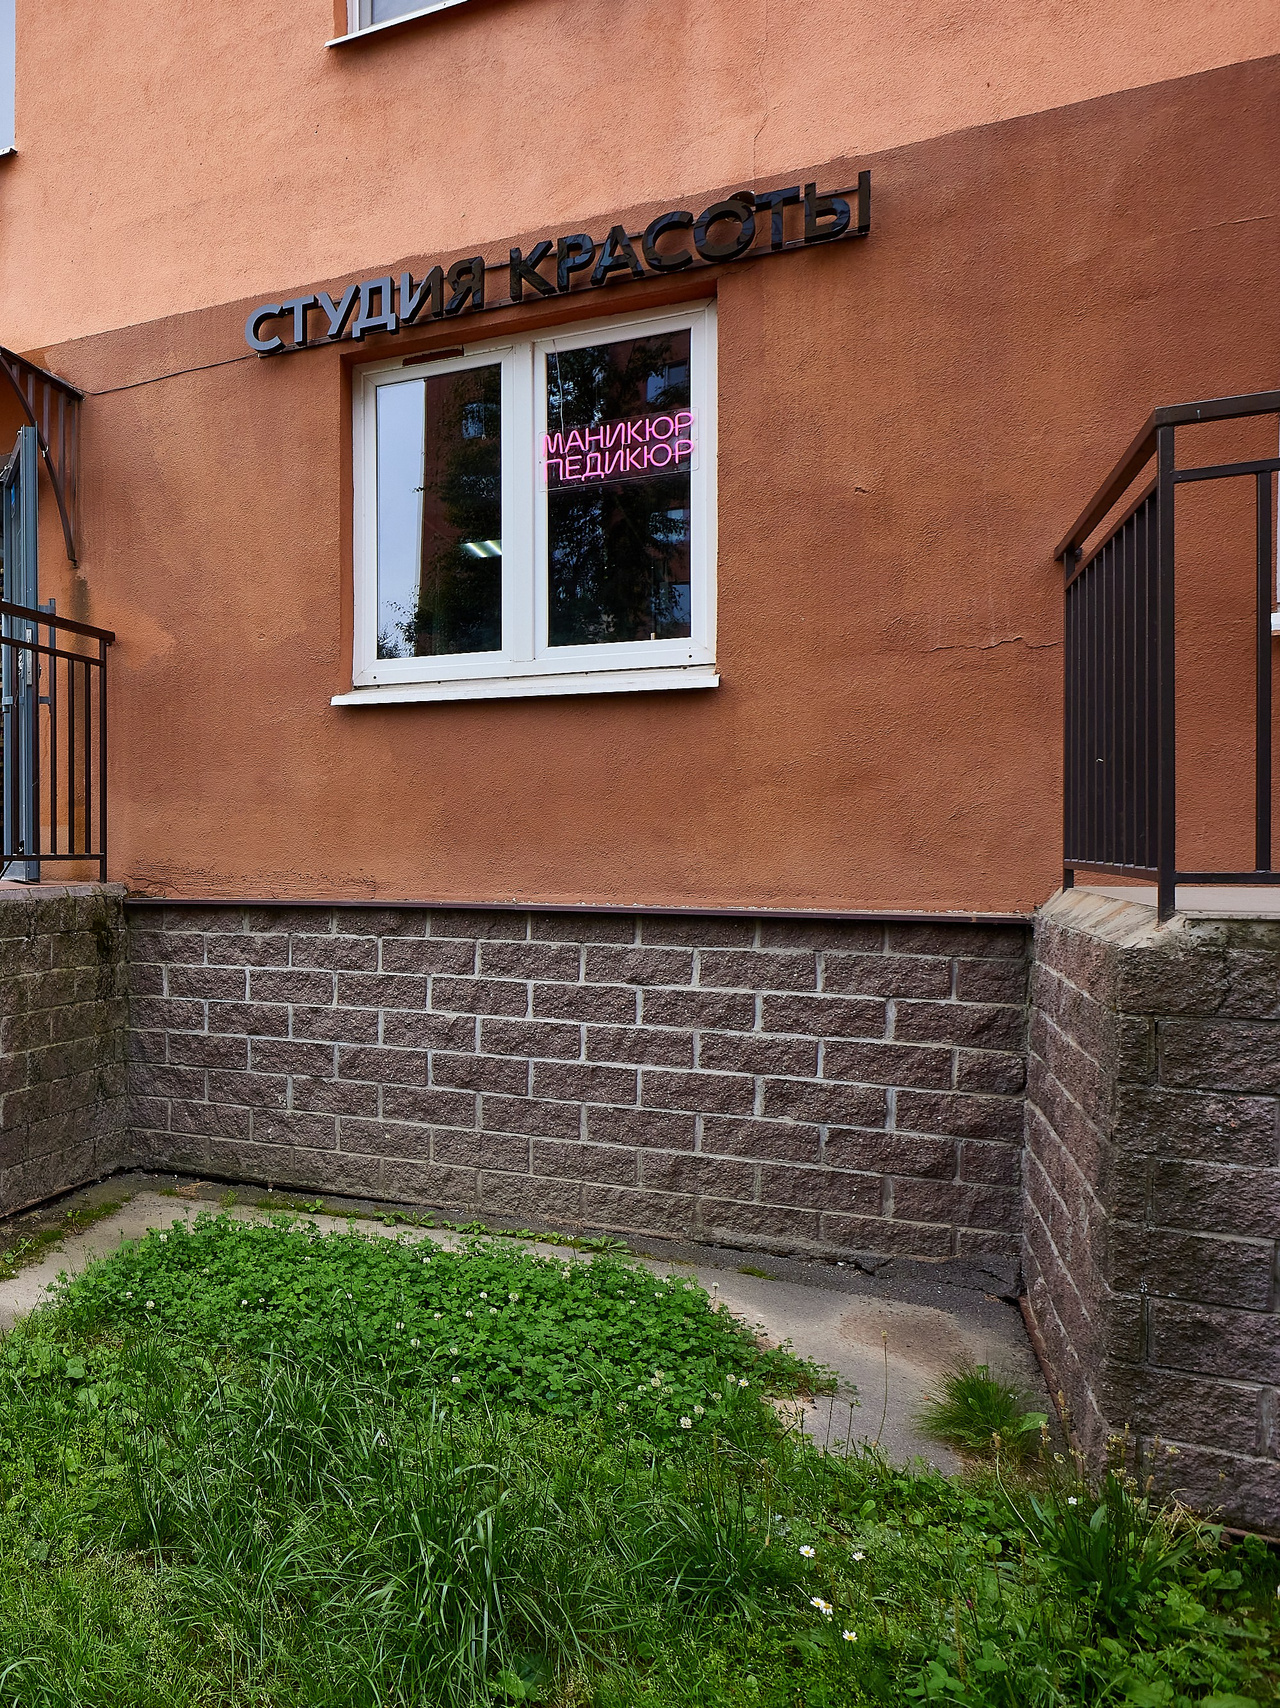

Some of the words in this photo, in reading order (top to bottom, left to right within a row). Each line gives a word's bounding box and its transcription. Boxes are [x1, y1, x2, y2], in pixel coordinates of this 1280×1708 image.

[245, 256, 485, 355] СТУДИЯ
[509, 170, 872, 302] КРАСОТЫ
[543, 412, 695, 456] МАНИКЮР
[543, 440, 695, 483] ПЕДИКЮР
